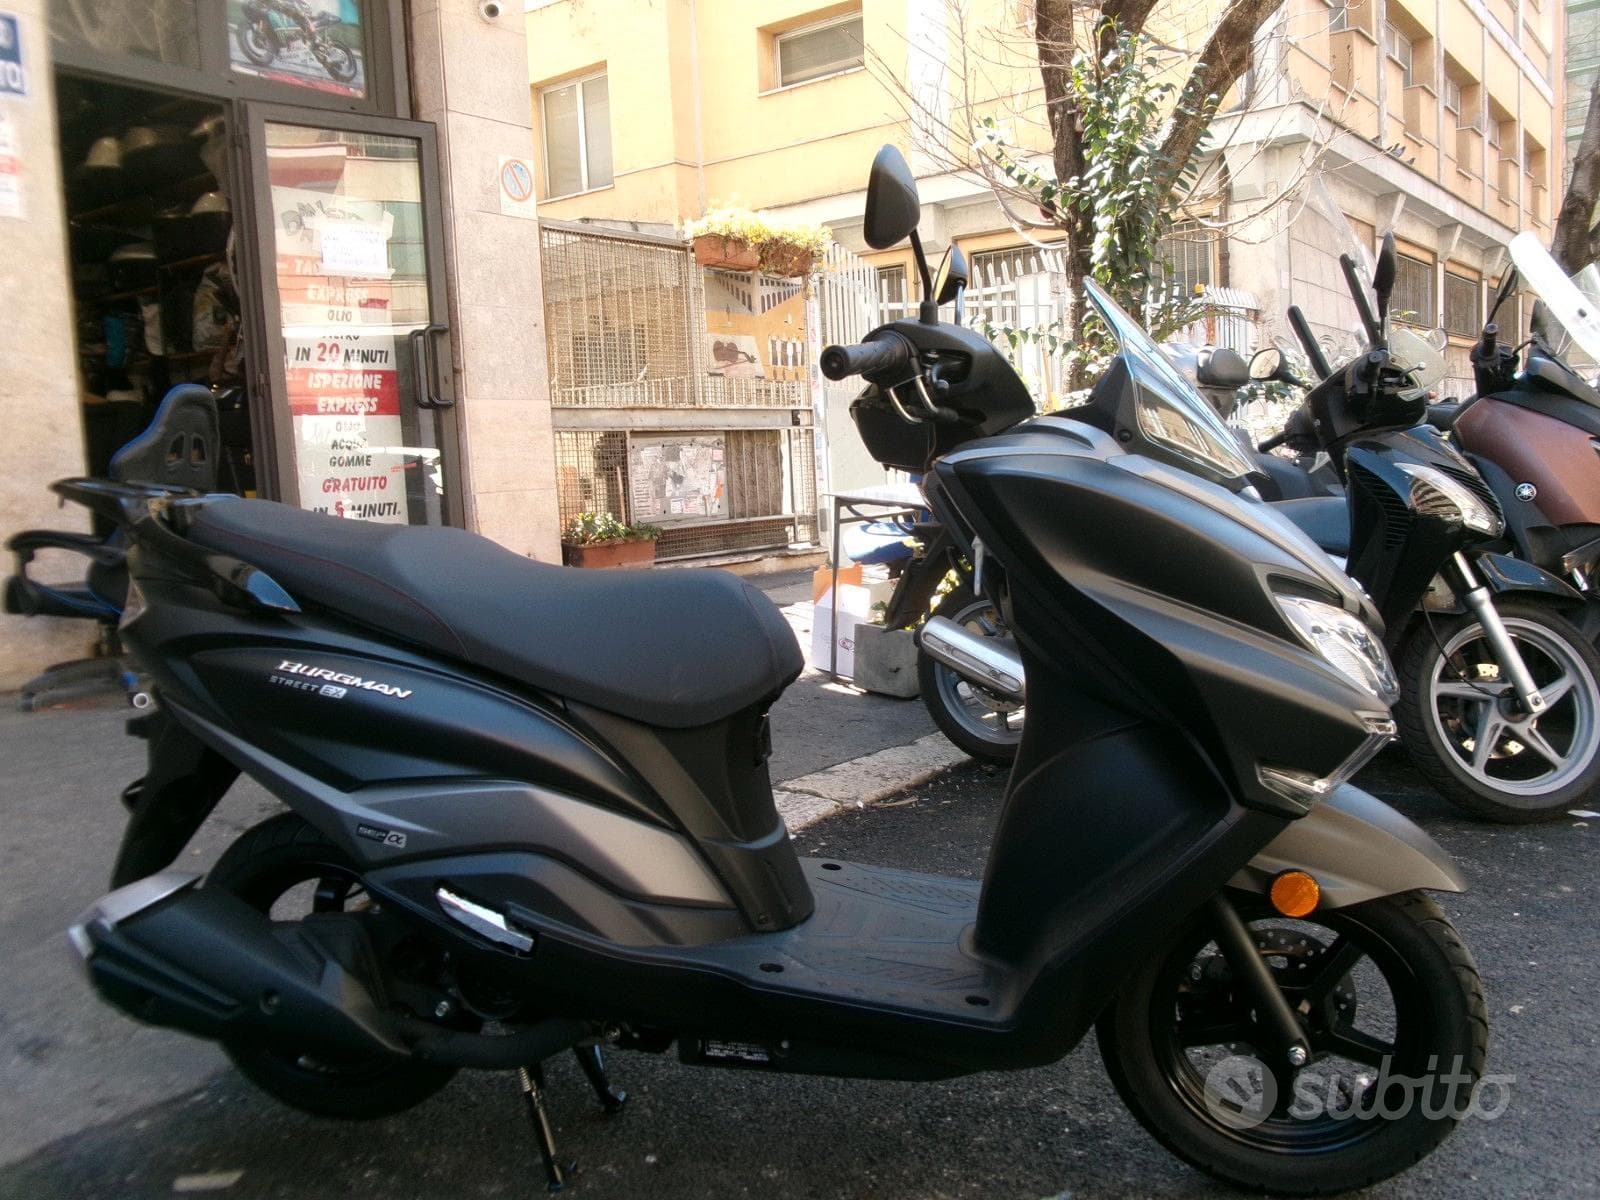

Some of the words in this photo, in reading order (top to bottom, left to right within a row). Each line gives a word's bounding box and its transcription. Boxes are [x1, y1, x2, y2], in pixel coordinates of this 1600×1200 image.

[327, 309, 353, 322] OLIO
[295, 346, 312, 361] IN
[317, 342, 340, 362] 20
[343, 349, 389, 364] MINUTI
[308, 372, 382, 390] ISPEZIONE
[317, 397, 378, 413] EXPRESS
[329, 455, 372, 467] GOMME
[322, 476, 387, 492] GRATUITO
[269, 675, 319, 692] STREET
[277, 660, 412, 698] BURGMAN
